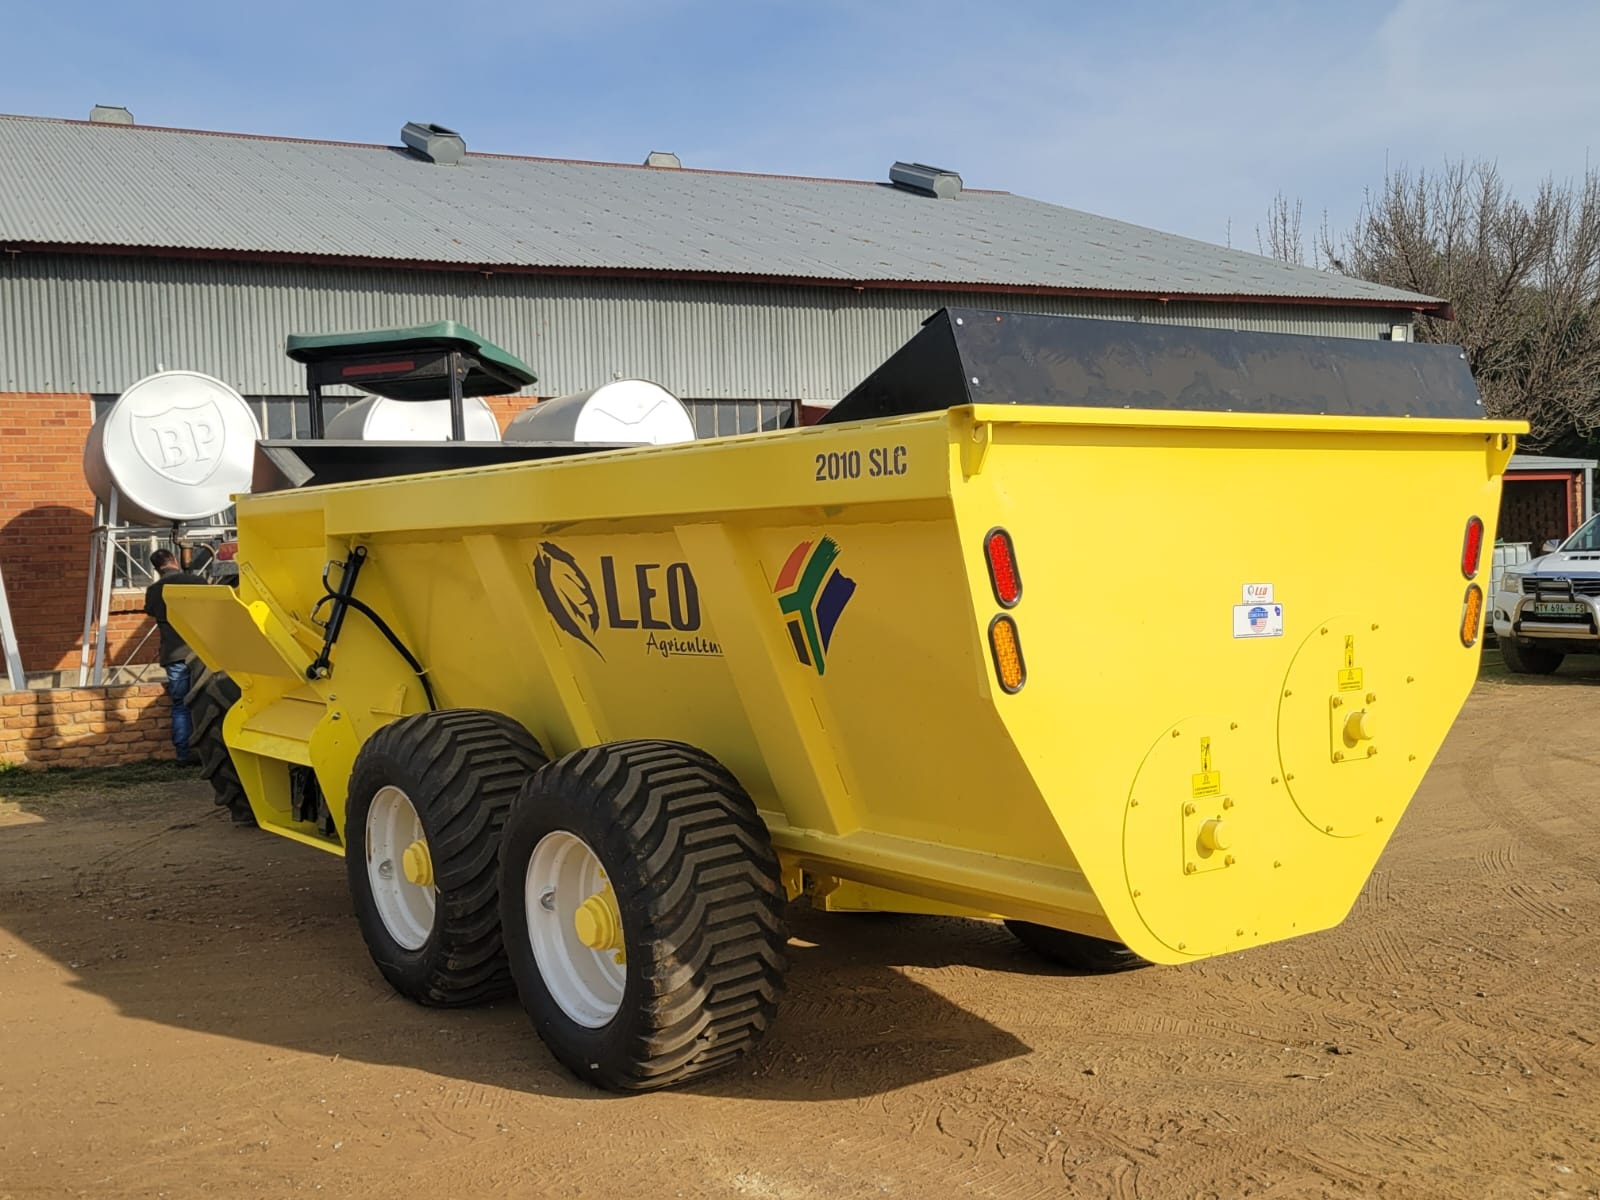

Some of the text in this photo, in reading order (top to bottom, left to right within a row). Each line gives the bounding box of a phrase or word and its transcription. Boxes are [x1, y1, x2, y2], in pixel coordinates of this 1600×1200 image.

[151, 419, 216, 469] BP
[815, 445, 907, 481] 2010 SLC
[600, 555, 701, 631] LEO
